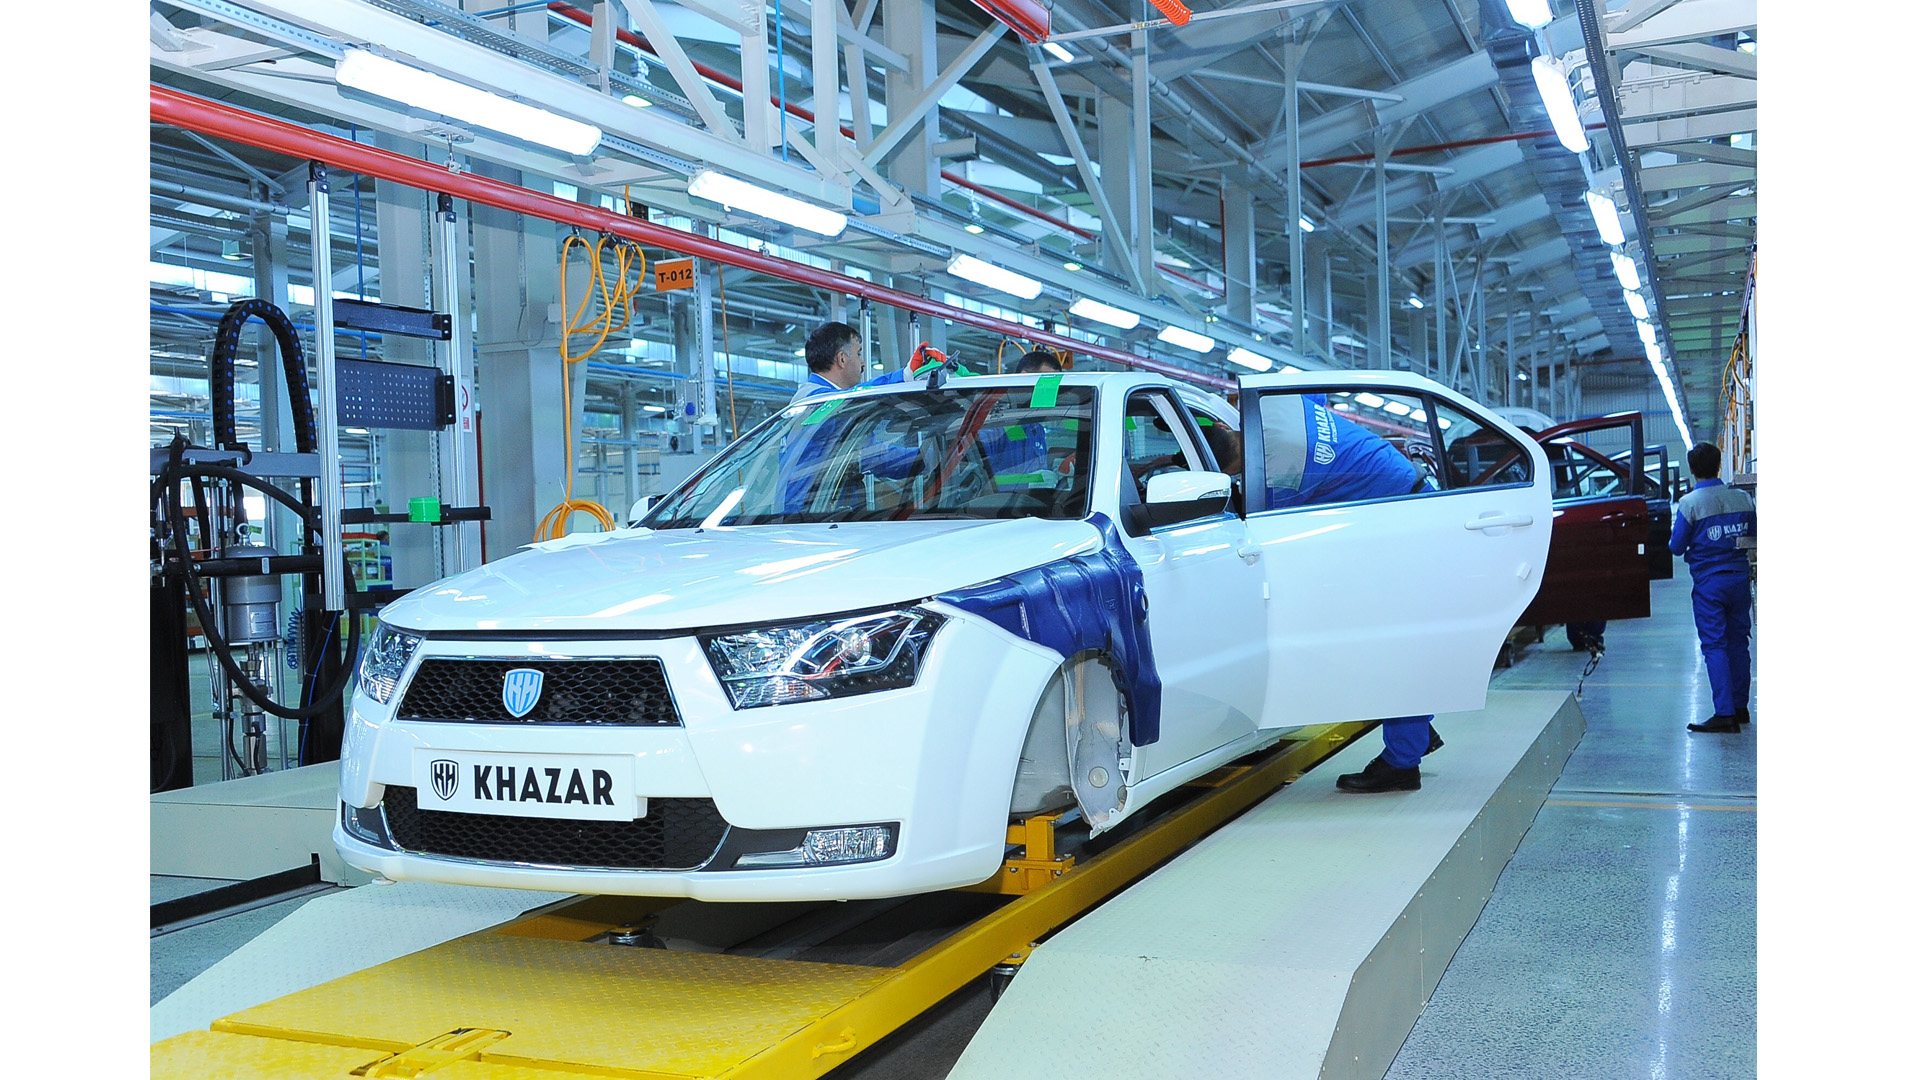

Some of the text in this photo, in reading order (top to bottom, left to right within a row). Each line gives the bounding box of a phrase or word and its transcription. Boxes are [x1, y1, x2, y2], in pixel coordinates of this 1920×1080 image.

[659, 269, 692, 283] T-012
[1314, 404, 1331, 442] KHAZAR
[474, 765, 615, 806] KHAZAR
